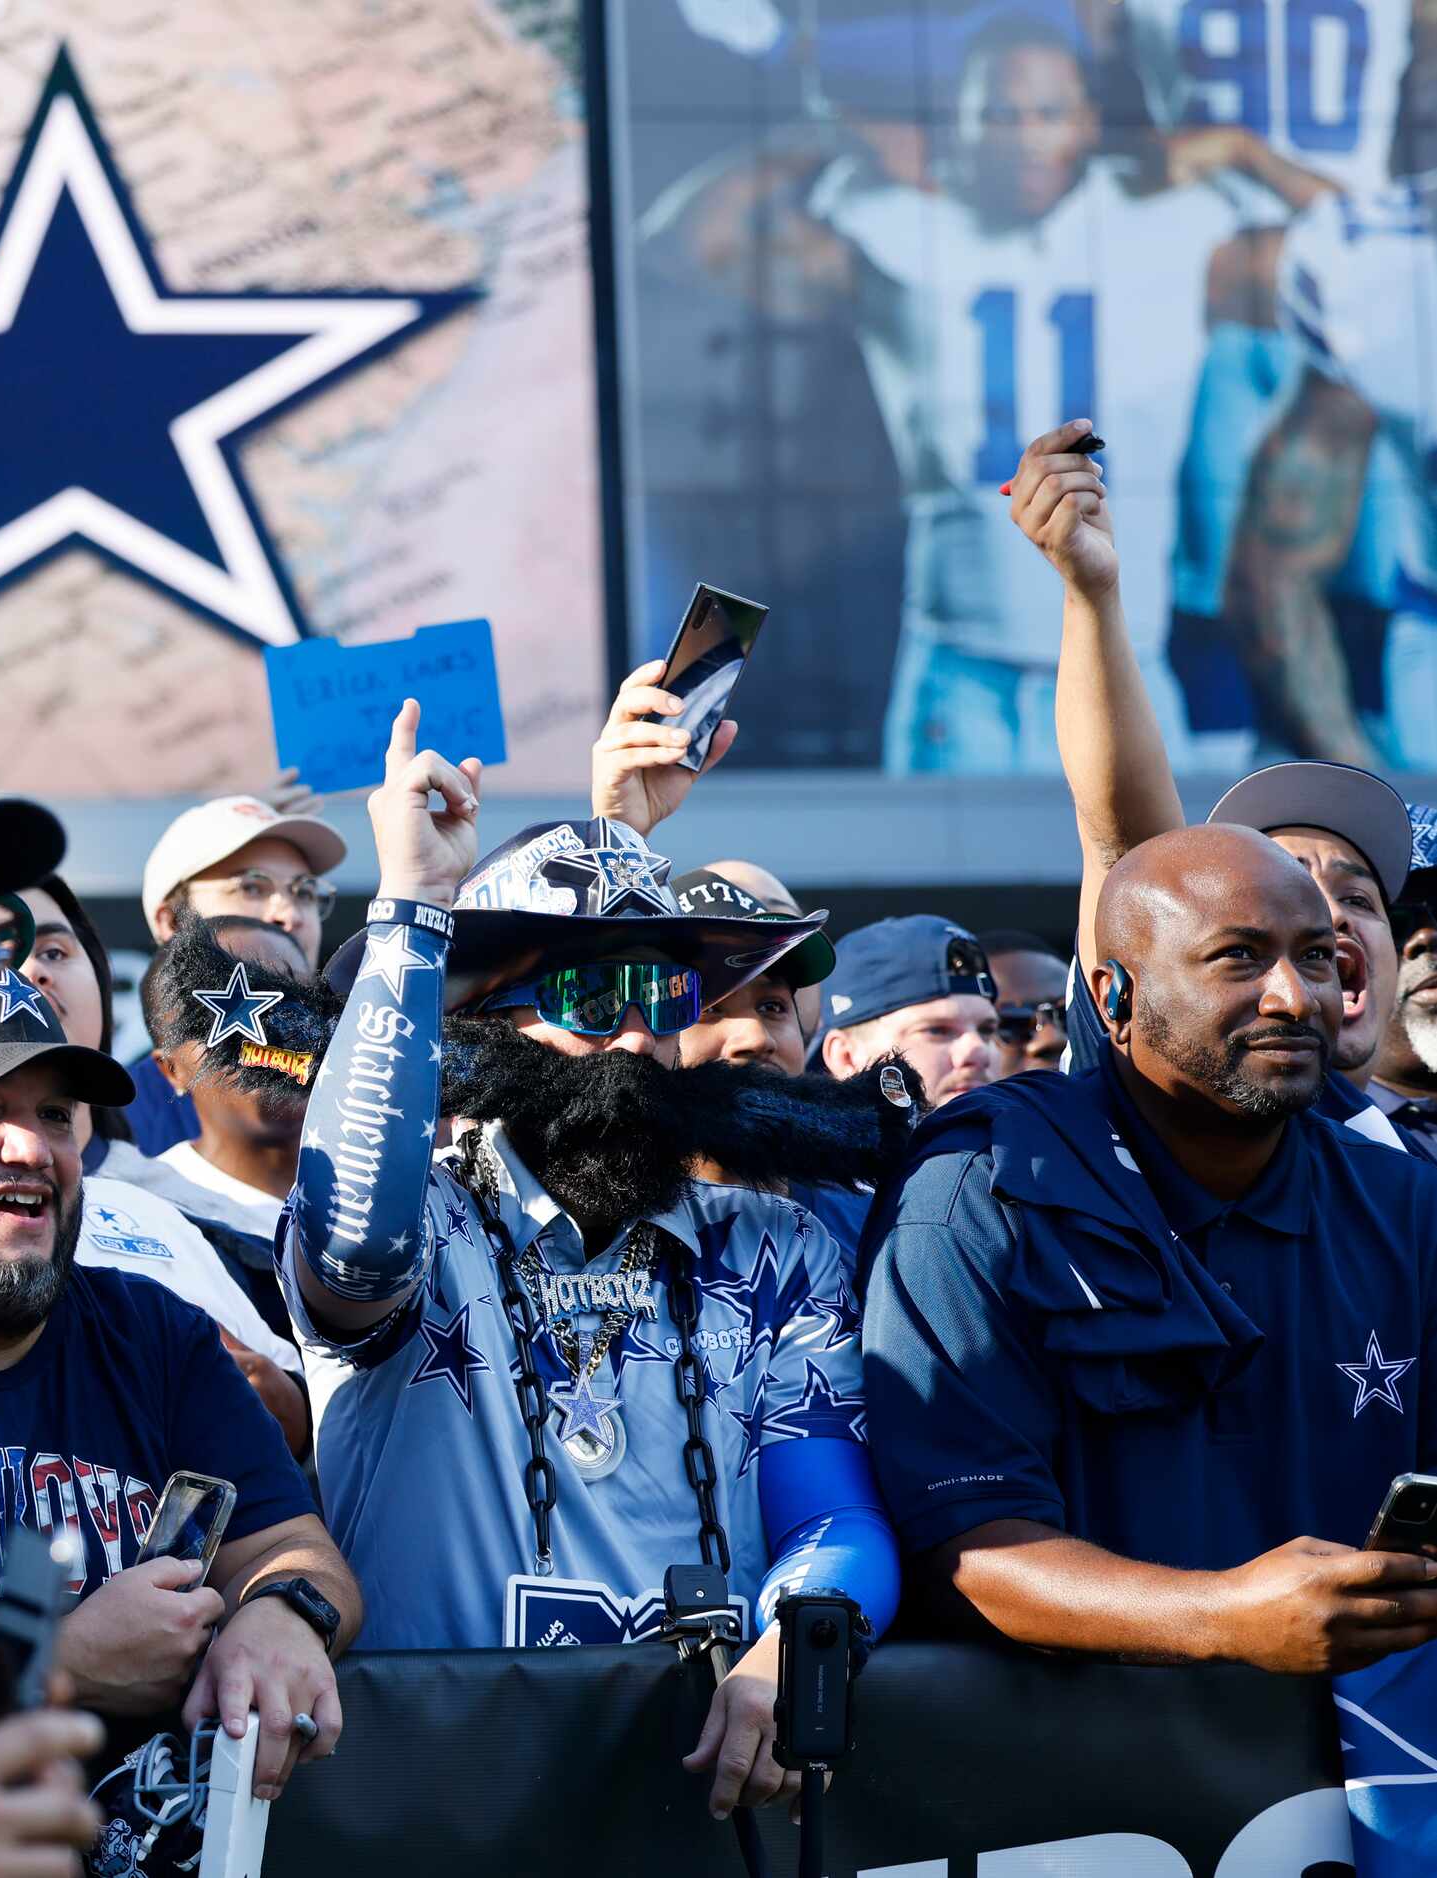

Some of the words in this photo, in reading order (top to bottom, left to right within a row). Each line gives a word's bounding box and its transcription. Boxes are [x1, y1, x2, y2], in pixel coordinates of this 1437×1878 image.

[1179, 0, 1369, 153] 90
[970, 289, 1108, 486] 11
[414, 904, 447, 933] TEAM
[325, 1001, 416, 1246] Stacheman
[538, 1271, 657, 1328] HOTBOYZ
[664, 1326, 752, 1356] CWBOYS
[927, 1474, 1004, 1490] OMNI-SHADE
